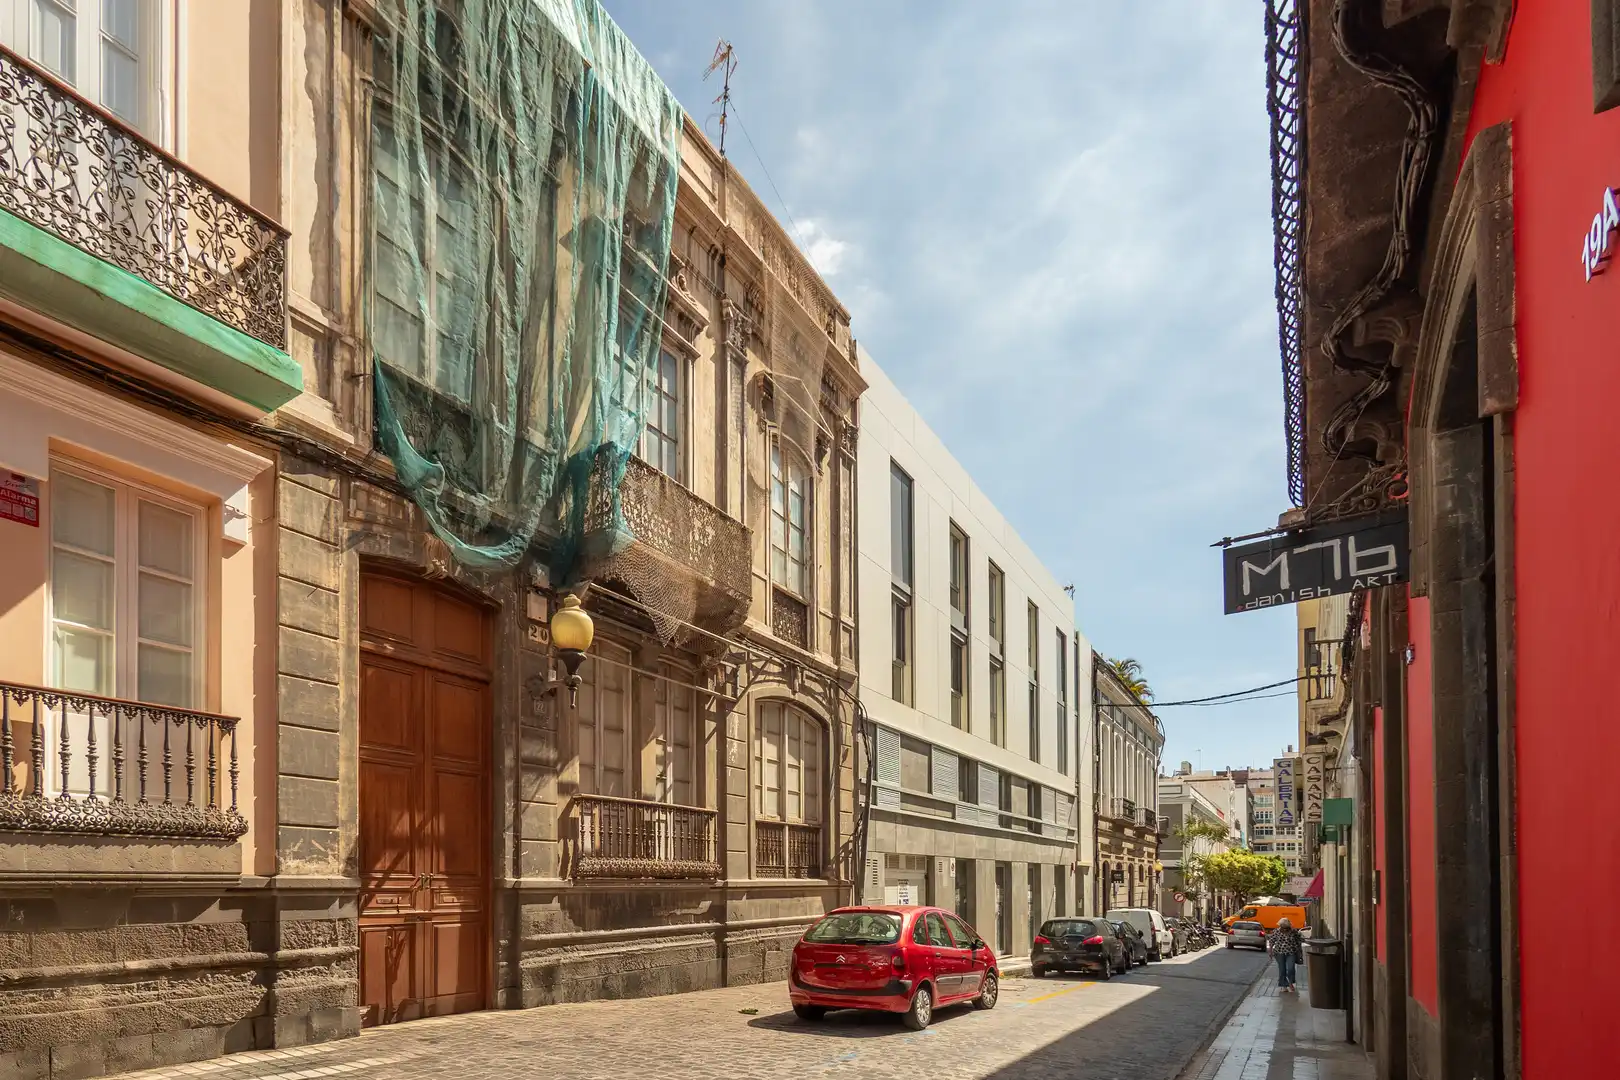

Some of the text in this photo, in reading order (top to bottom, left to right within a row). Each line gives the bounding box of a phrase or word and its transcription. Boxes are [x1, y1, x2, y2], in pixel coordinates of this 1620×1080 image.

[1581, 186, 1619, 283] 19A
[0, 488, 37, 505] Alarma
[1244, 572, 1398, 610] danish ART
[530, 625, 548, 642] 20
[1277, 760, 1293, 824] GALERIAS
